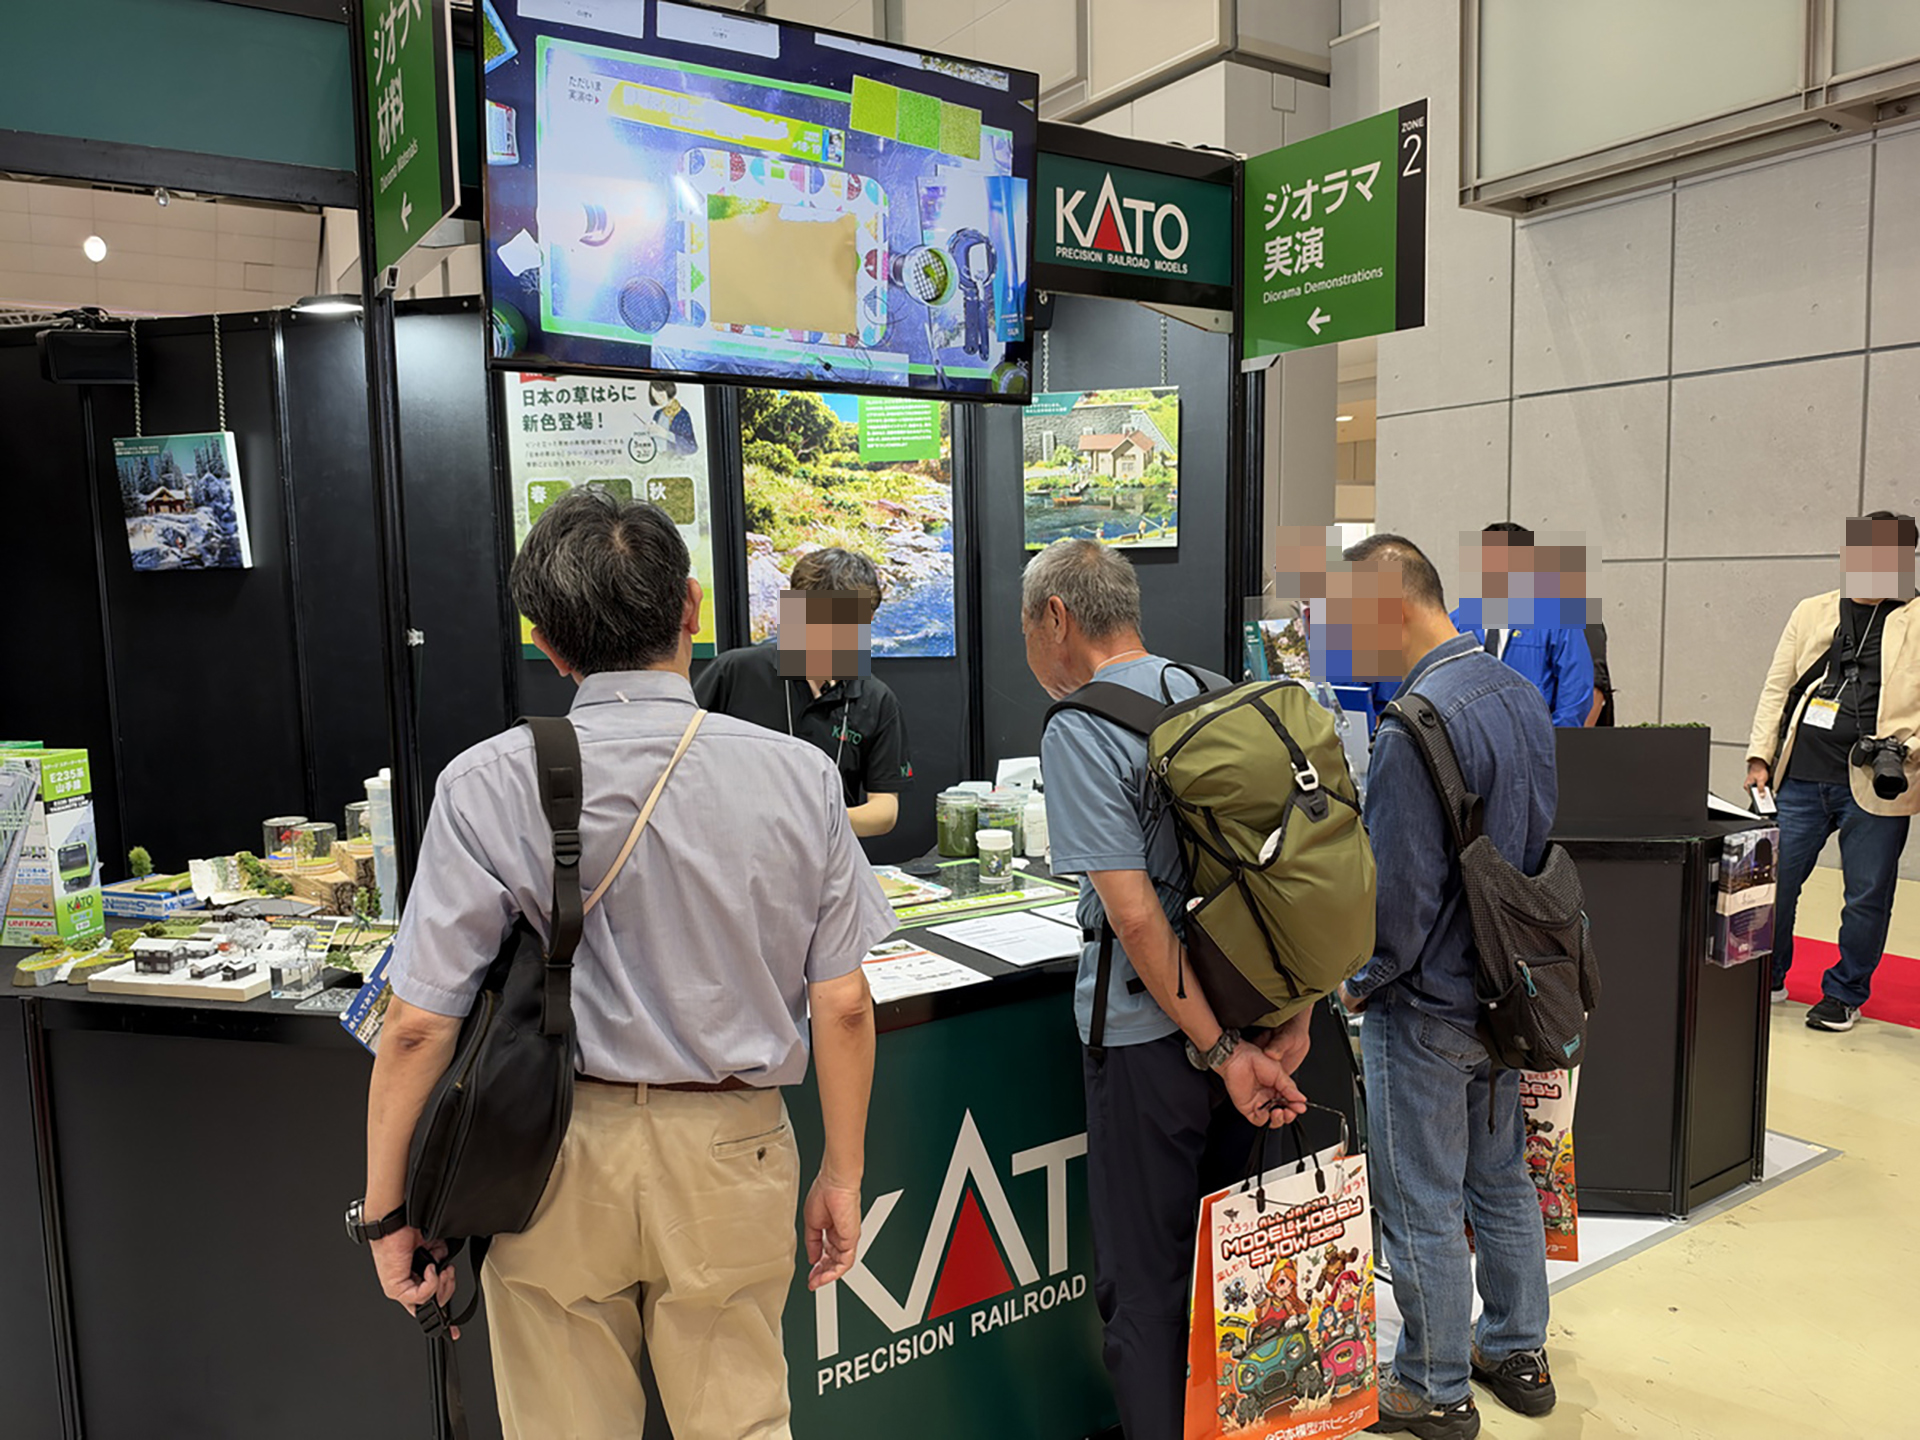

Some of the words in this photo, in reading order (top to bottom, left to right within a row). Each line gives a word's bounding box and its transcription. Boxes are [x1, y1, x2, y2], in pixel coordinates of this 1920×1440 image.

[374, 0, 421, 85] ジオラ
[568, 76, 601, 91] ただいま
[1401, 116, 1425, 133] ZONE
[1402, 134, 1423, 178] 2
[1264, 161, 1382, 232] ジオラマ
[1055, 171, 1190, 261] KATO
[1056, 246, 1103, 263] PRECISION
[1107, 252, 1151, 270] RAILROAD
[1155, 259, 1189, 275] MODELS
[1263, 226, 1325, 282] 実演
[1263, 284, 1301, 304] Diorama
[1304, 266, 1384, 295] Demonstrations
[522, 384, 637, 407] 日本の草はらに
[522, 411, 603, 433] 新色登場！
[530, 485, 547, 504] 春
[649, 482, 667, 501] 秋
[67, 895, 94, 914] KATO
[1258, 1213, 1284, 1228] ALL
[1286, 1196, 1328, 1219] JAPAN
[815, 1106, 1088, 1361] KAT
[817, 1321, 954, 1396] PRECISION
[971, 1273, 1086, 1338] RAILROAD
